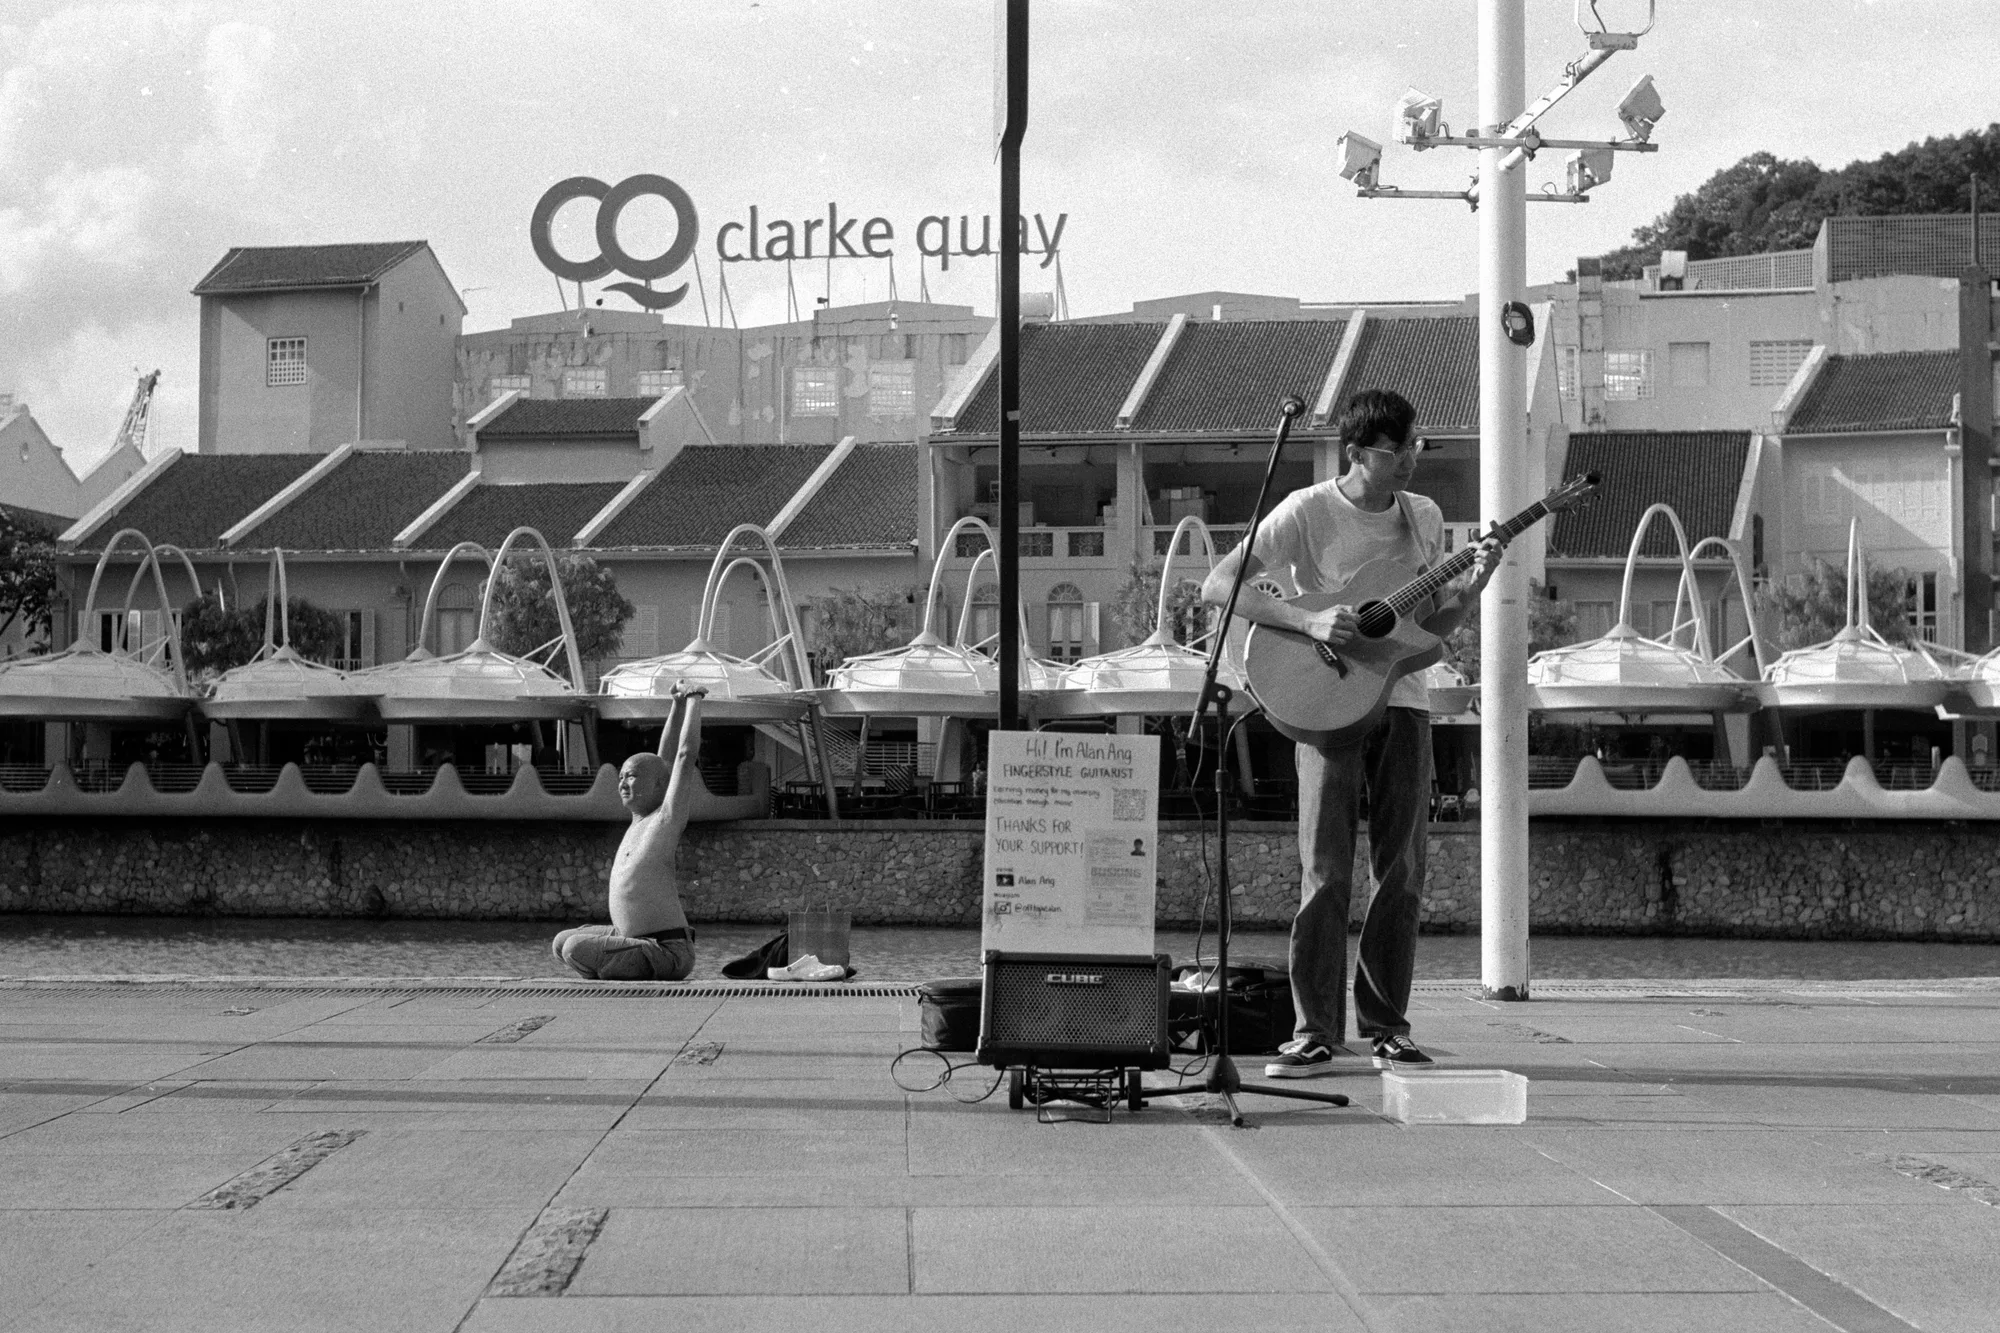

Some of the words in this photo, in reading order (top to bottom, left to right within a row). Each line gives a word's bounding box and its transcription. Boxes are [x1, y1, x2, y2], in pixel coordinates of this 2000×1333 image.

[716, 202, 893, 263] clarke
[1026, 738, 1046, 760] Hi!
[1075, 741, 1104, 760] Alan
[1106, 742, 1132, 765] Ang
[1003, 764, 1072, 779] FINGERSTYLE
[1080, 766, 1134, 780] GUITARIST
[996, 816, 1047, 834] THANKS
[1052, 819, 1072, 834] FOR
[995, 838, 1024, 853] YOUR
[1030, 840, 1084, 859] SUPPORT!
[1018, 876, 1036, 885] Alan
[1039, 875, 1056, 888] Ang
[1047, 974, 1103, 984] CUBE
